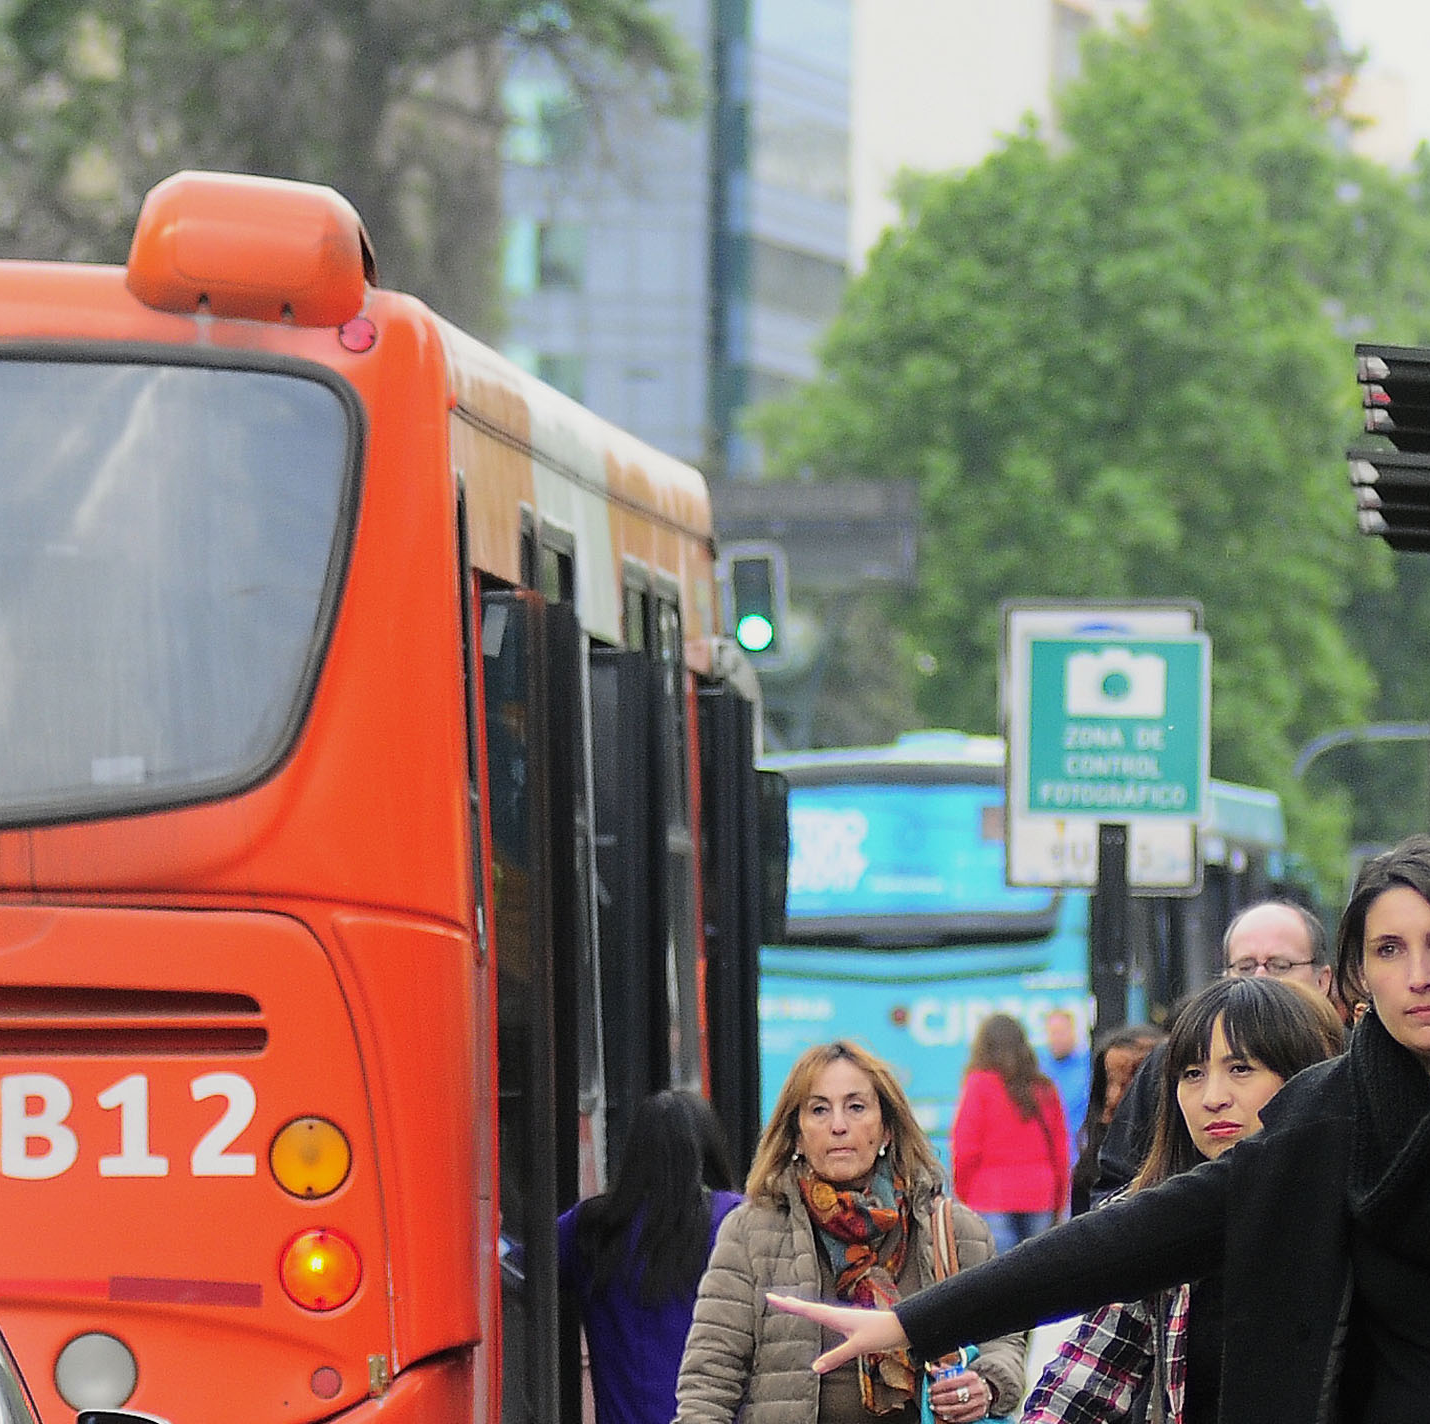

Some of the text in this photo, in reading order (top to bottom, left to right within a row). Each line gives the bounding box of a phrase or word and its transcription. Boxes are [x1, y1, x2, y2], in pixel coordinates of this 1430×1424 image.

[1064, 725, 1166, 750] ZONA DE
[1065, 754, 1161, 779] CONTROL
